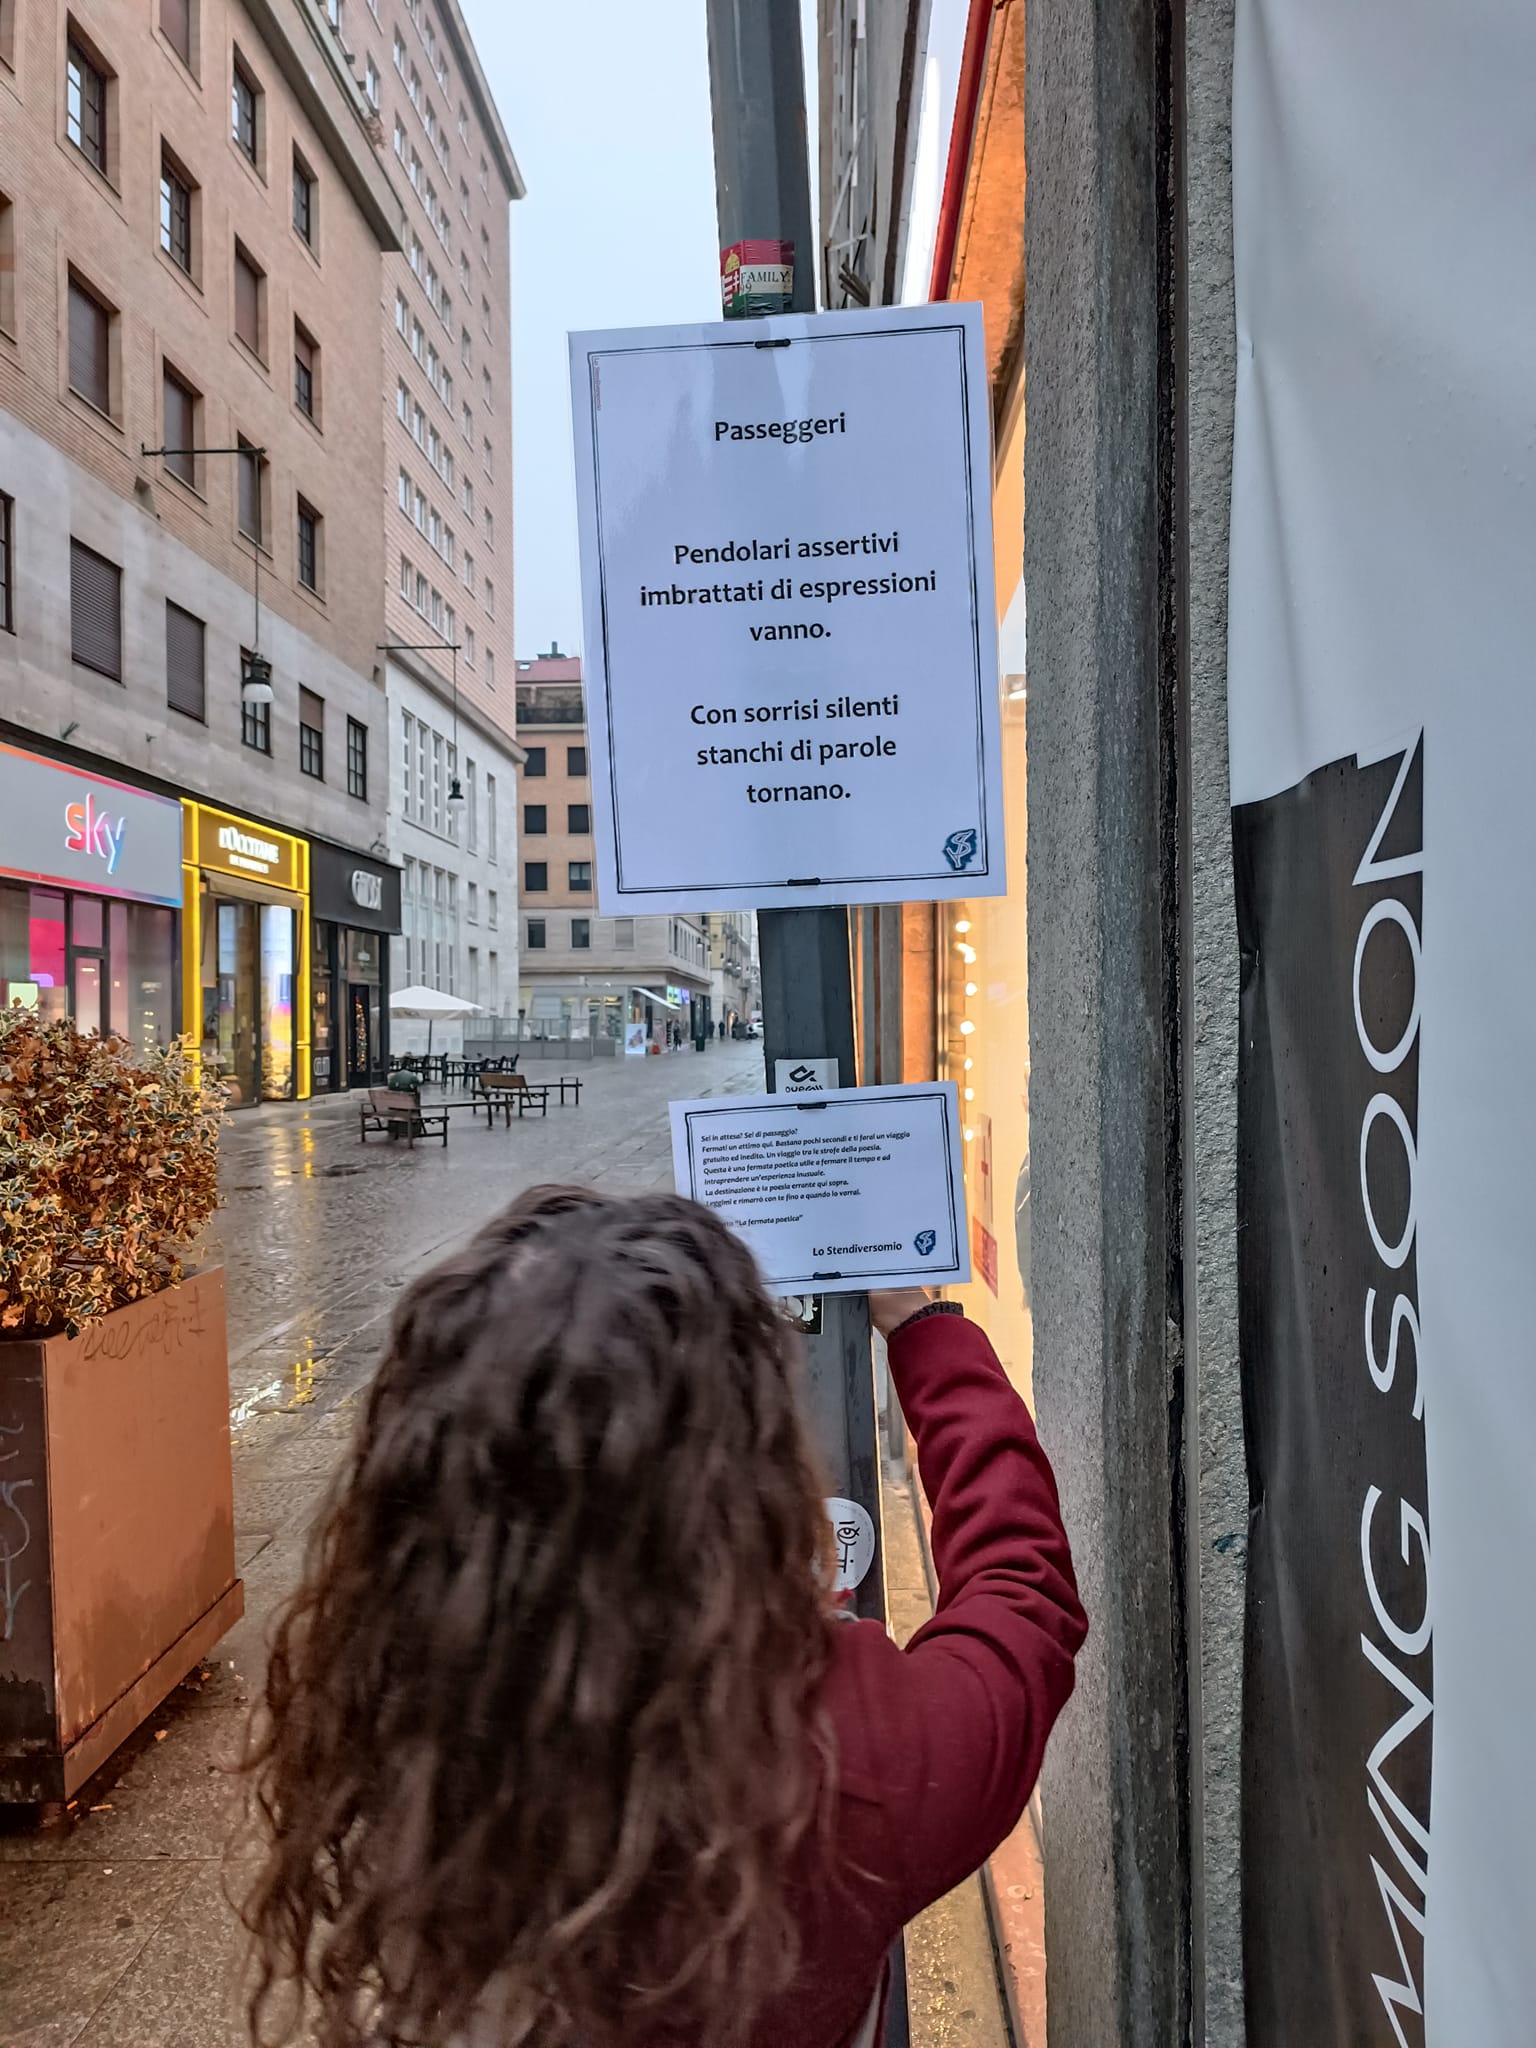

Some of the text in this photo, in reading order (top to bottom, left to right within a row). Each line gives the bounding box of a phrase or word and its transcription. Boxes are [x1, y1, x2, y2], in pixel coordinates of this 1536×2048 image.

[715, 412, 845, 444] Passeggeri
[674, 531, 898, 564] Pendolari assertivi
[641, 570, 936, 606] imbrattati di espressioni
[749, 623, 831, 641] vanno.
[691, 694, 898, 724] Con sorrisi silenti
[697, 735, 896, 765] stanchi di parole
[746, 784, 851, 803] tornano.
[65, 793, 126, 874] sky
[813, 1241, 902, 1256] Lo Stendiversomio
